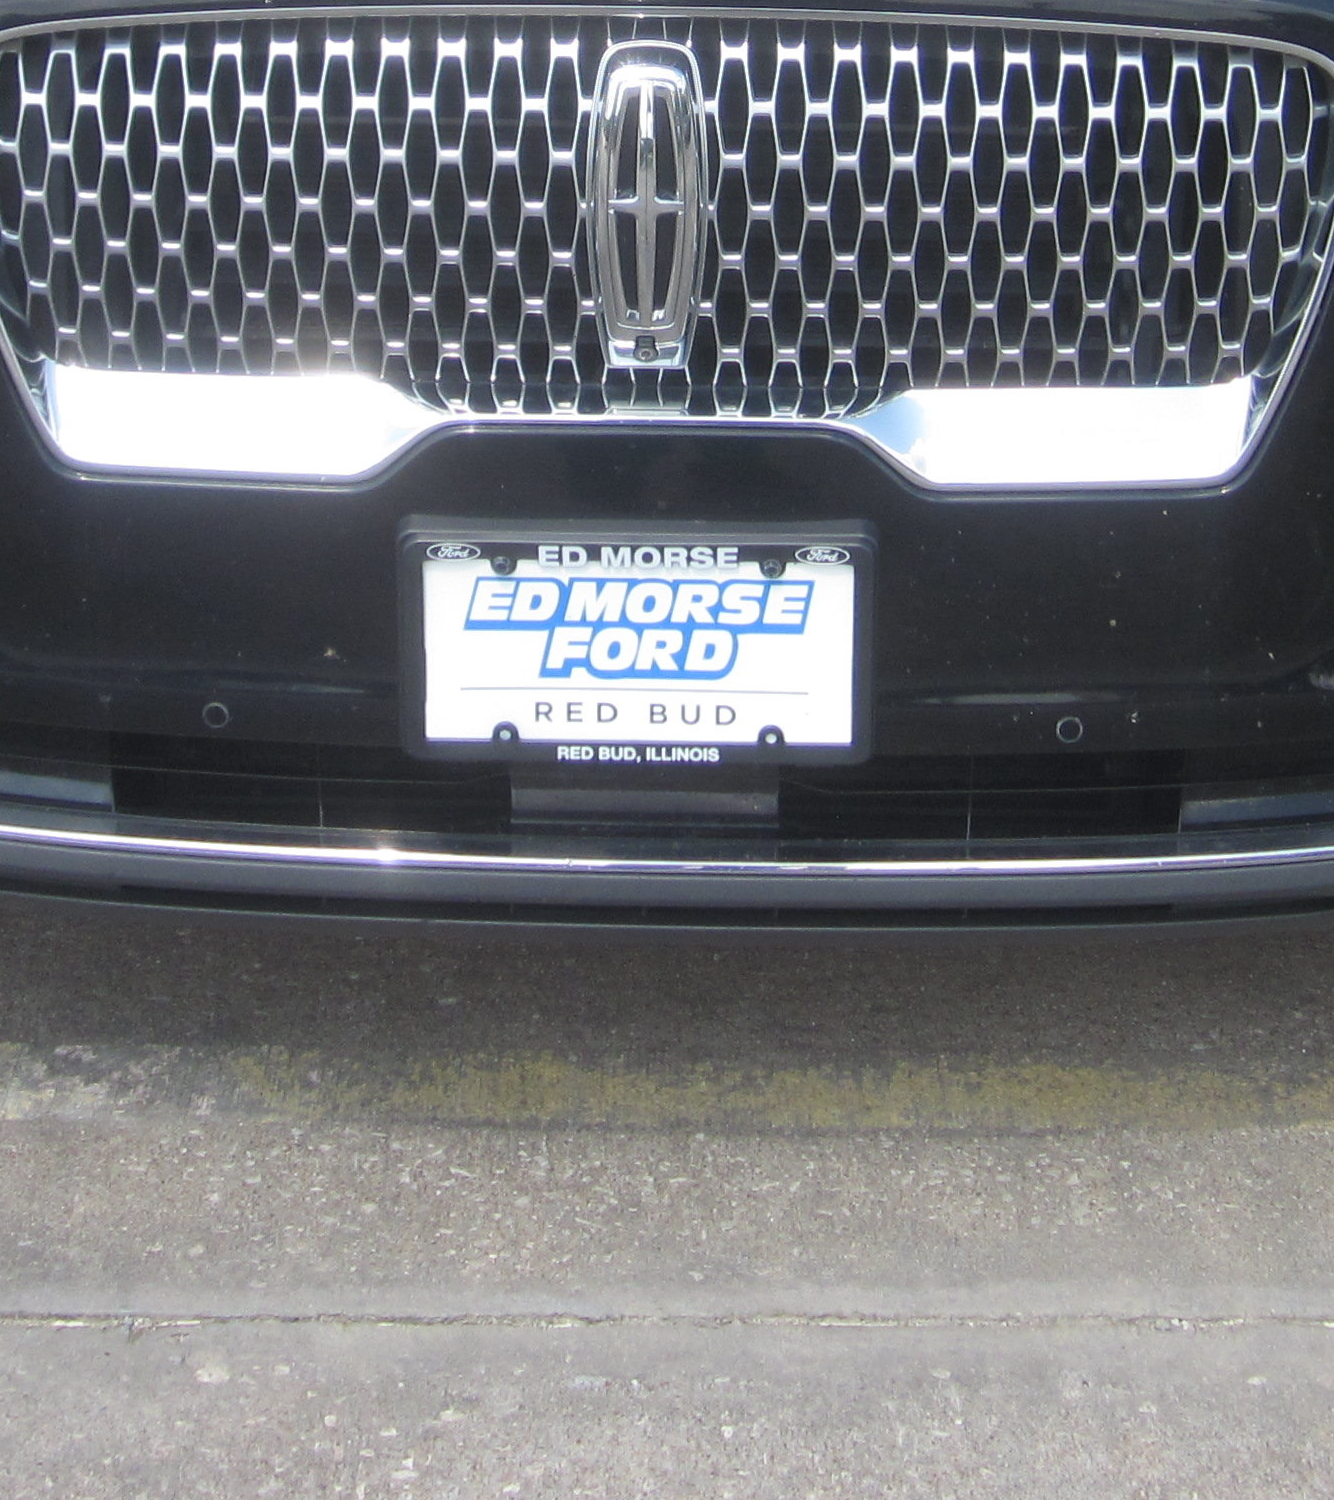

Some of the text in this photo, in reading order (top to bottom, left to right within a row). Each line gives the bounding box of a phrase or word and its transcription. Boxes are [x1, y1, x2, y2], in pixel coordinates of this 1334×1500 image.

[437, 545, 470, 558] Ford
[538, 545, 739, 569] ED MORSE
[806, 549, 839, 562] Ford
[466, 578, 814, 630] ED MORSE
[541, 626, 737, 675] FORD
[535, 702, 736, 726] RED BUD
[557, 746, 720, 764] RED BUD, ILLINOIS
